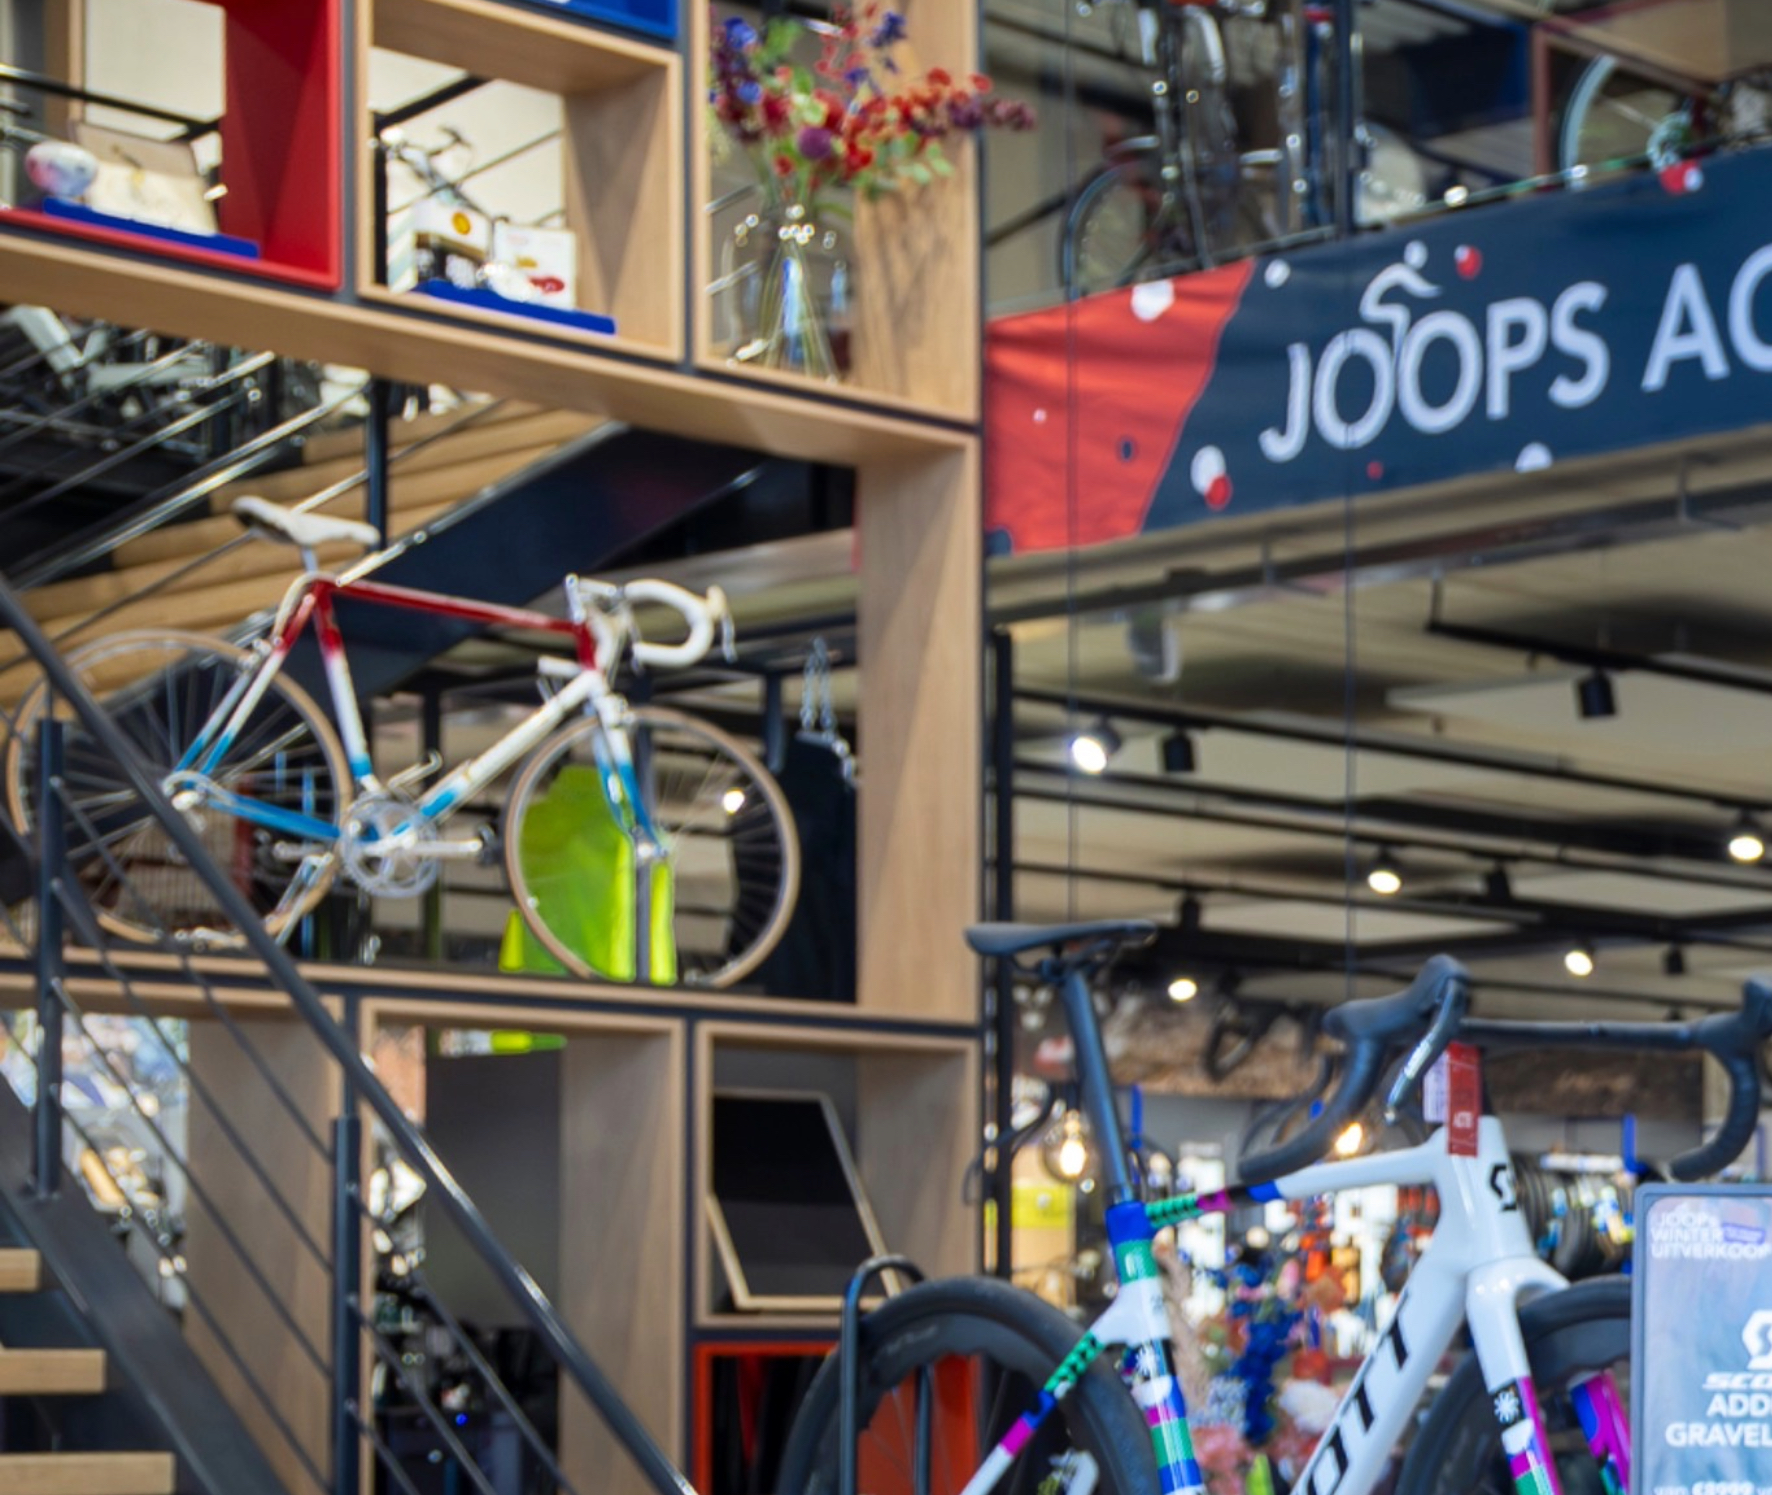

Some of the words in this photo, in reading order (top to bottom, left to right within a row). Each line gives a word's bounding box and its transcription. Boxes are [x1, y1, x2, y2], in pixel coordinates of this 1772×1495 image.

[1260, 280, 1608, 462] JOOPS
[1651, 1228, 1723, 1243] WINTER
[1652, 1243, 1772, 1259] UITVERKOOP
